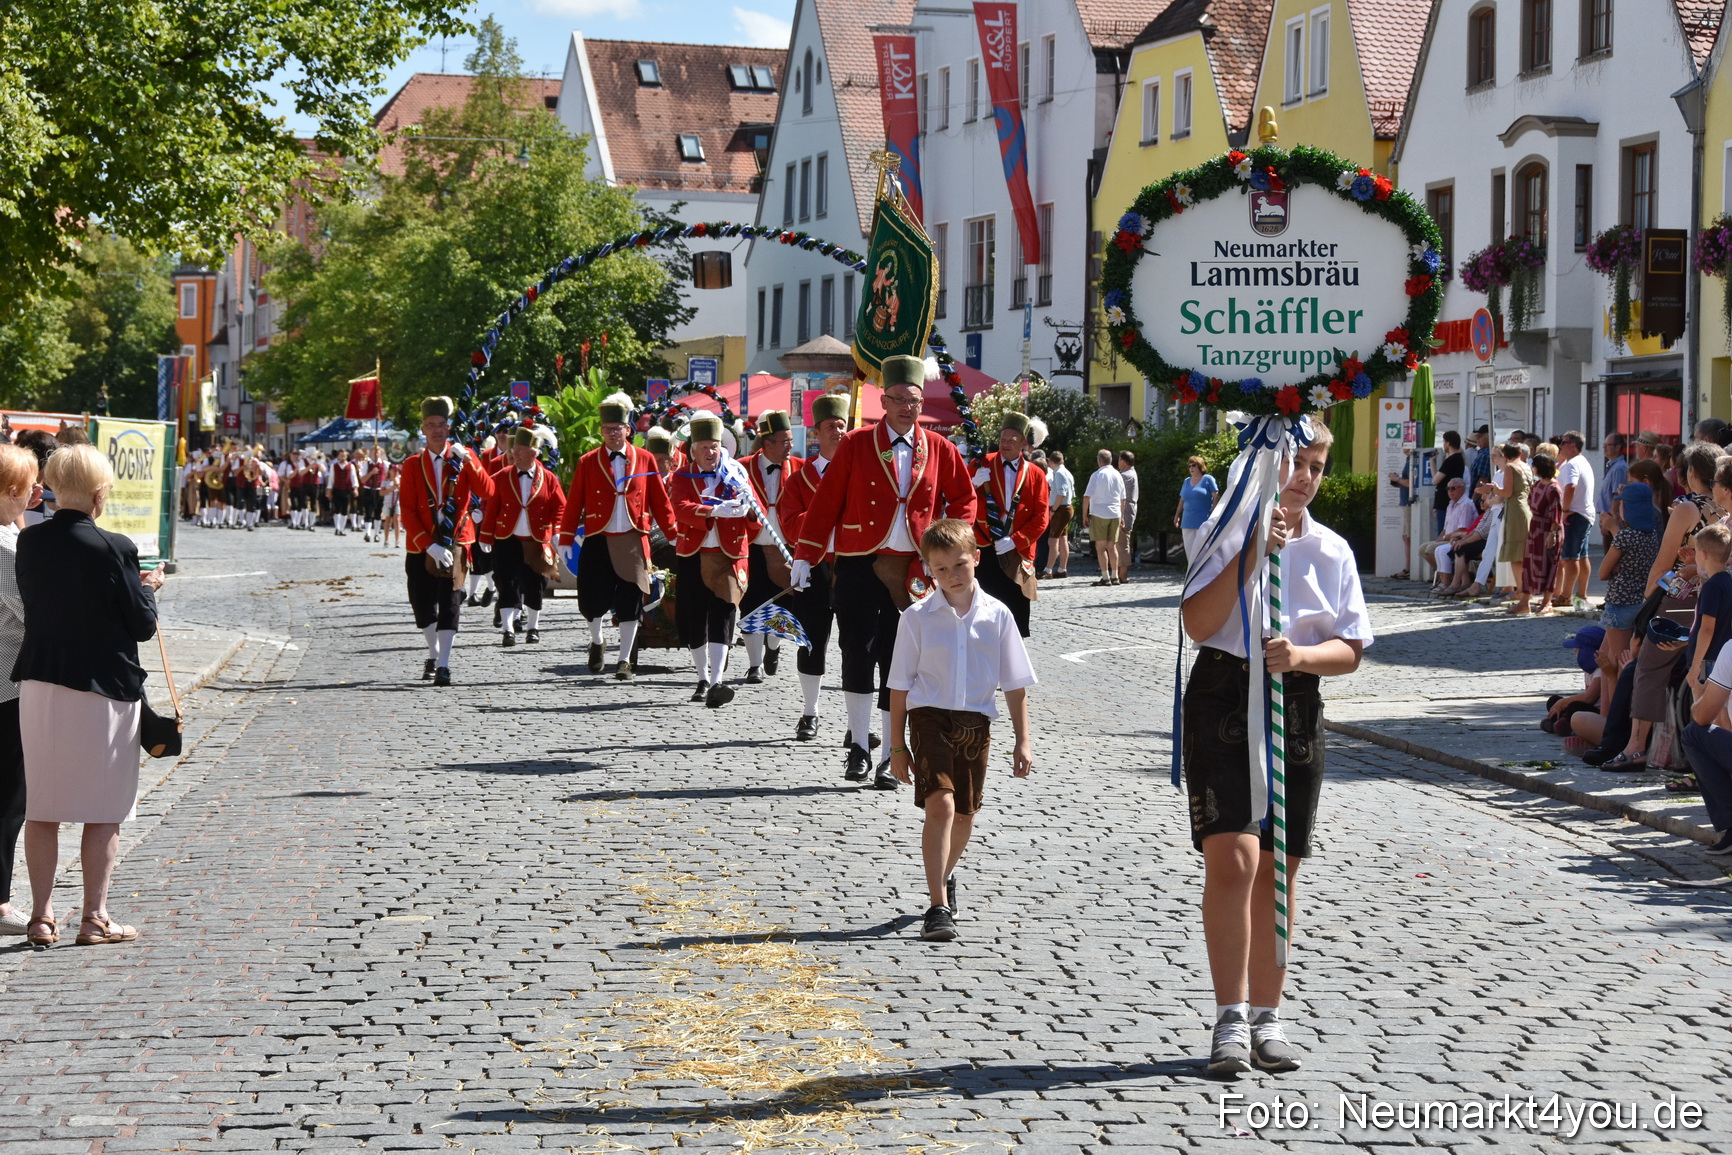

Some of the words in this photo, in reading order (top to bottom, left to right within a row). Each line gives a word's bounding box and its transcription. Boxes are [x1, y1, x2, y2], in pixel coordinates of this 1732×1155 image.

[984, 10, 1005, 68] K&L
[1003, 11, 1013, 71] RUPPERT
[1214, 239, 1338, 257] Neumarkter
[1190, 261, 1359, 286] Lammsbräu
[1180, 297, 1363, 334] Schäffler
[741, 378, 747, 392] P
[1499, 373, 1523, 385] APOTHEKE
[930, 423, 952, 432] Lehme
